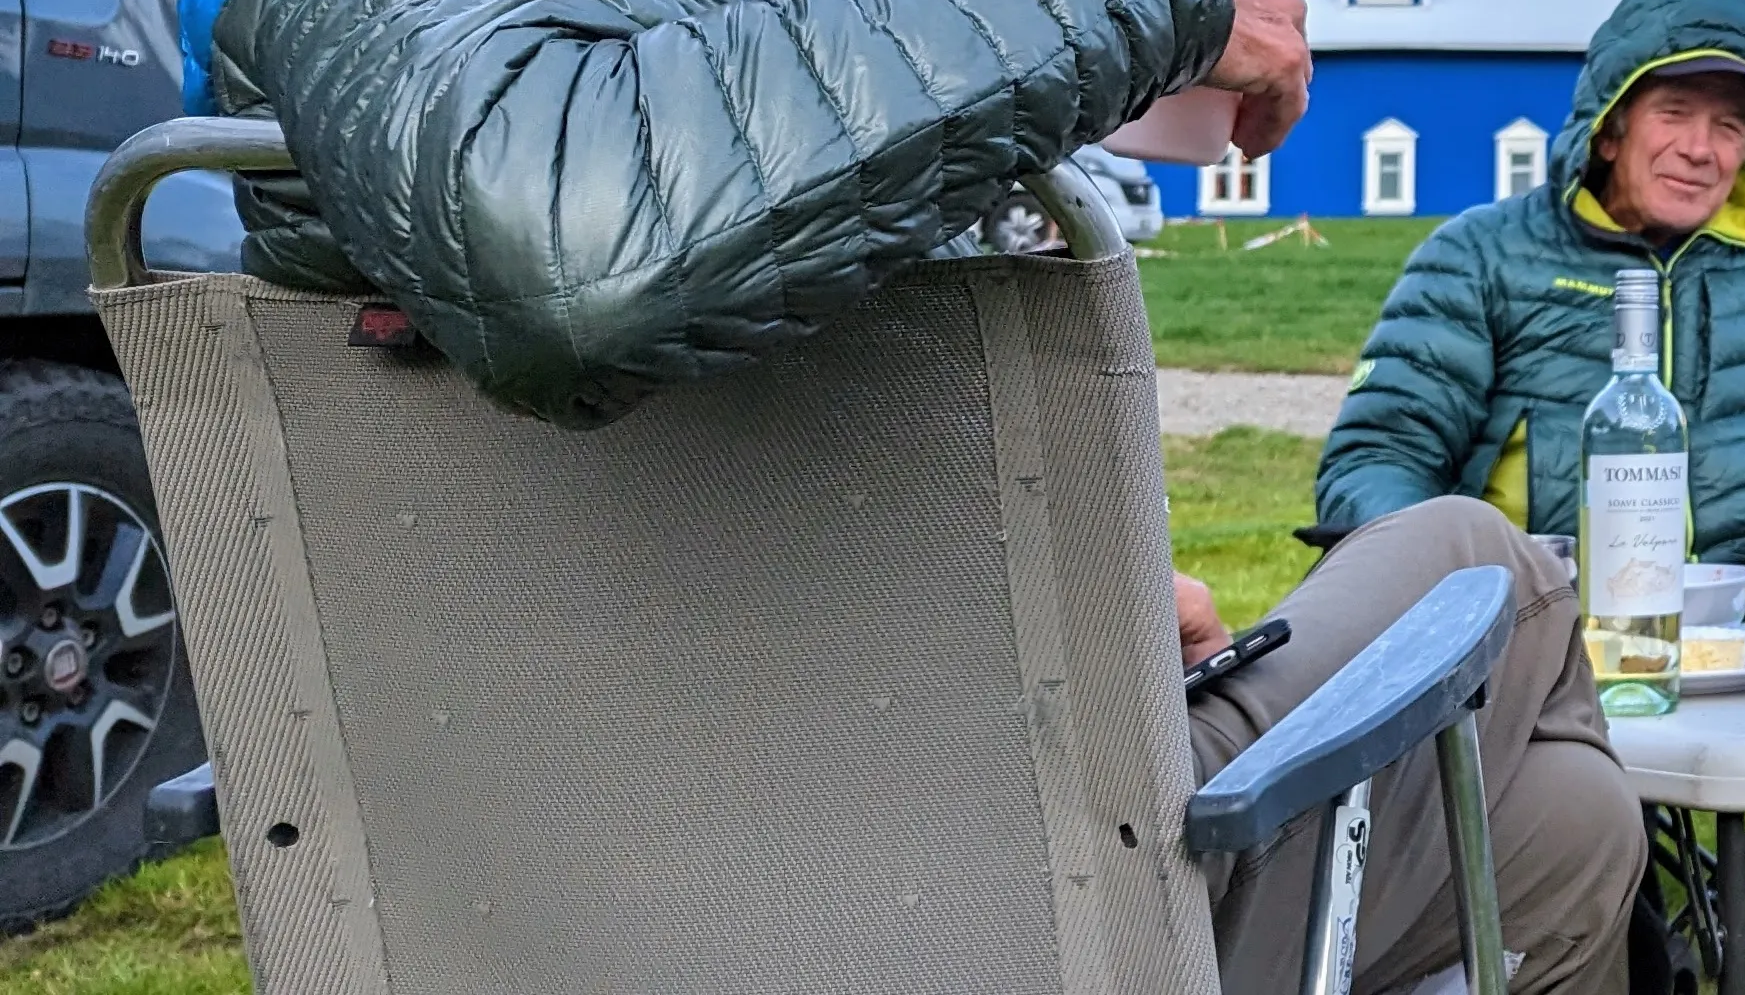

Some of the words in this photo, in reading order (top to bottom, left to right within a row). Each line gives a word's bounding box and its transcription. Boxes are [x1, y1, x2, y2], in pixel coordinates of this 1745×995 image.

[99, 45, 140, 66] 140
[1604, 466, 1683, 482] TOMMASI
[1607, 498, 1637, 508] SOAVE
